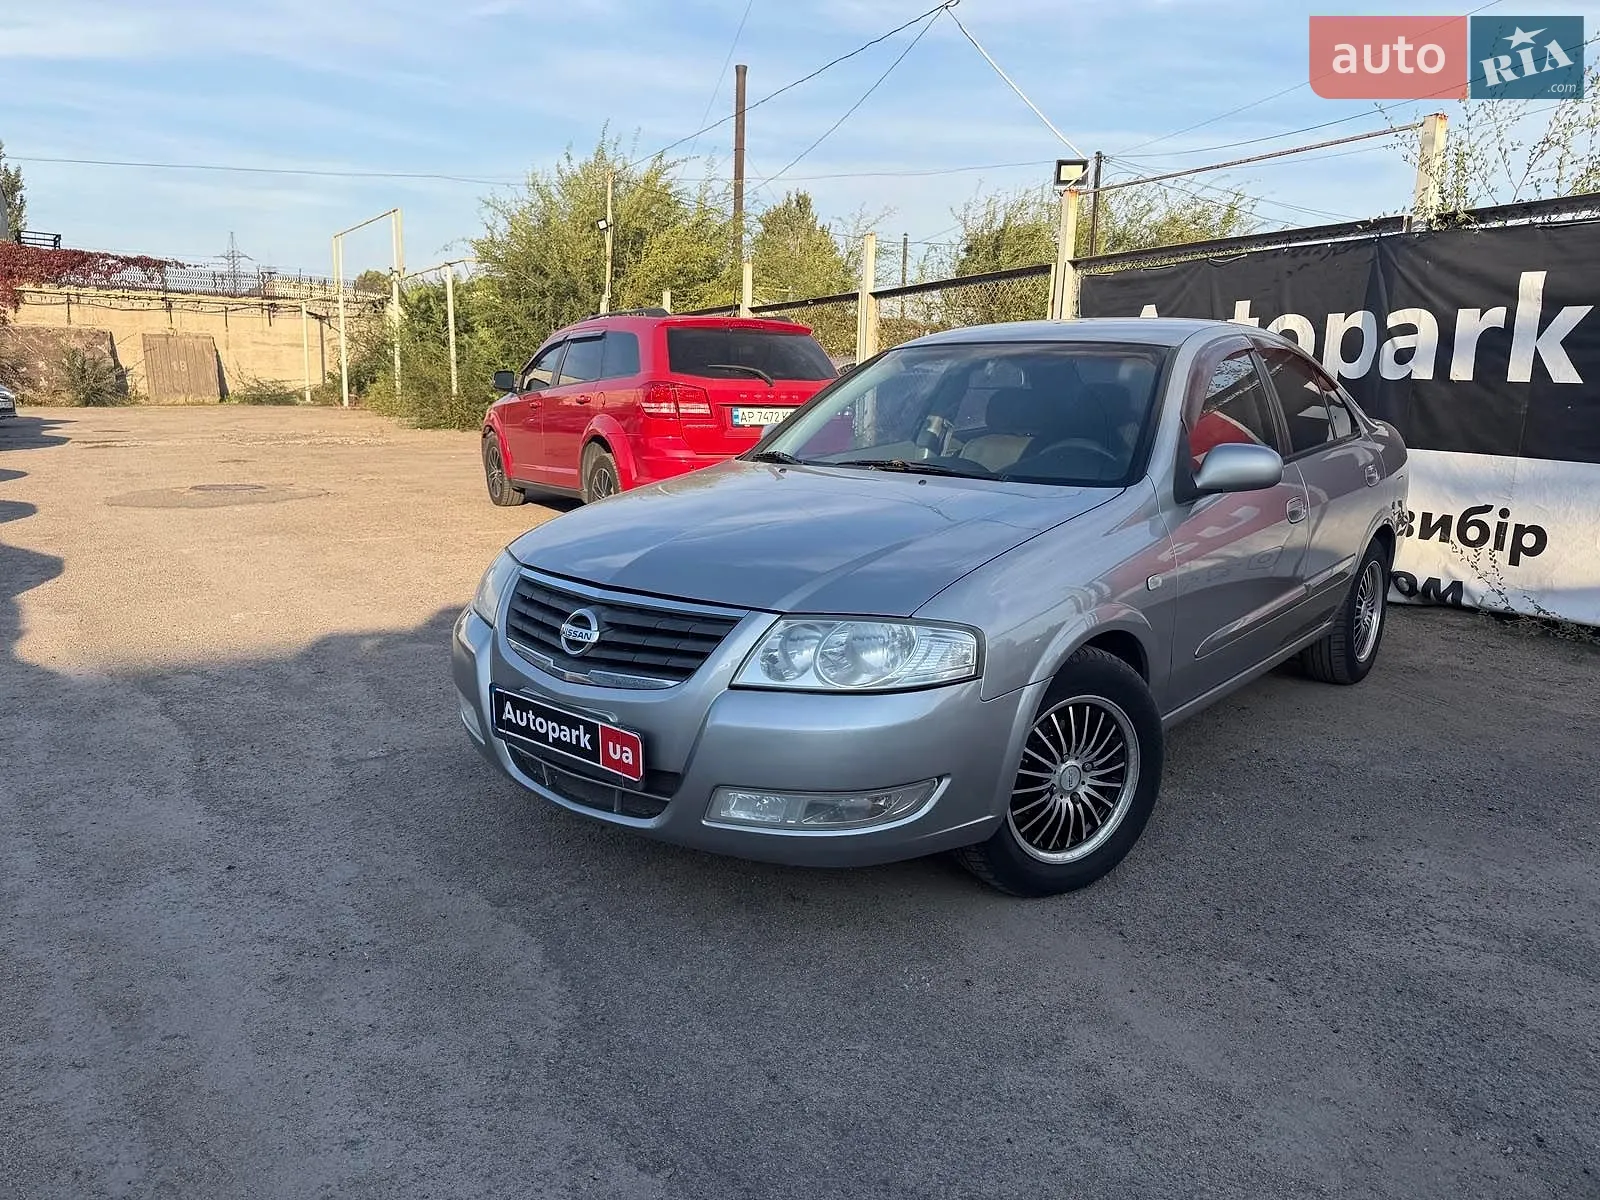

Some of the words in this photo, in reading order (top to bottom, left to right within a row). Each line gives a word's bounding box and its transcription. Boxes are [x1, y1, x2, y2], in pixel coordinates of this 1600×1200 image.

[1139, 271, 1595, 385] opark
[740, 411, 755, 423] AP
[757, 411, 780, 423] 7472
[502, 700, 593, 751] Autopark
[608, 741, 634, 765] ua
